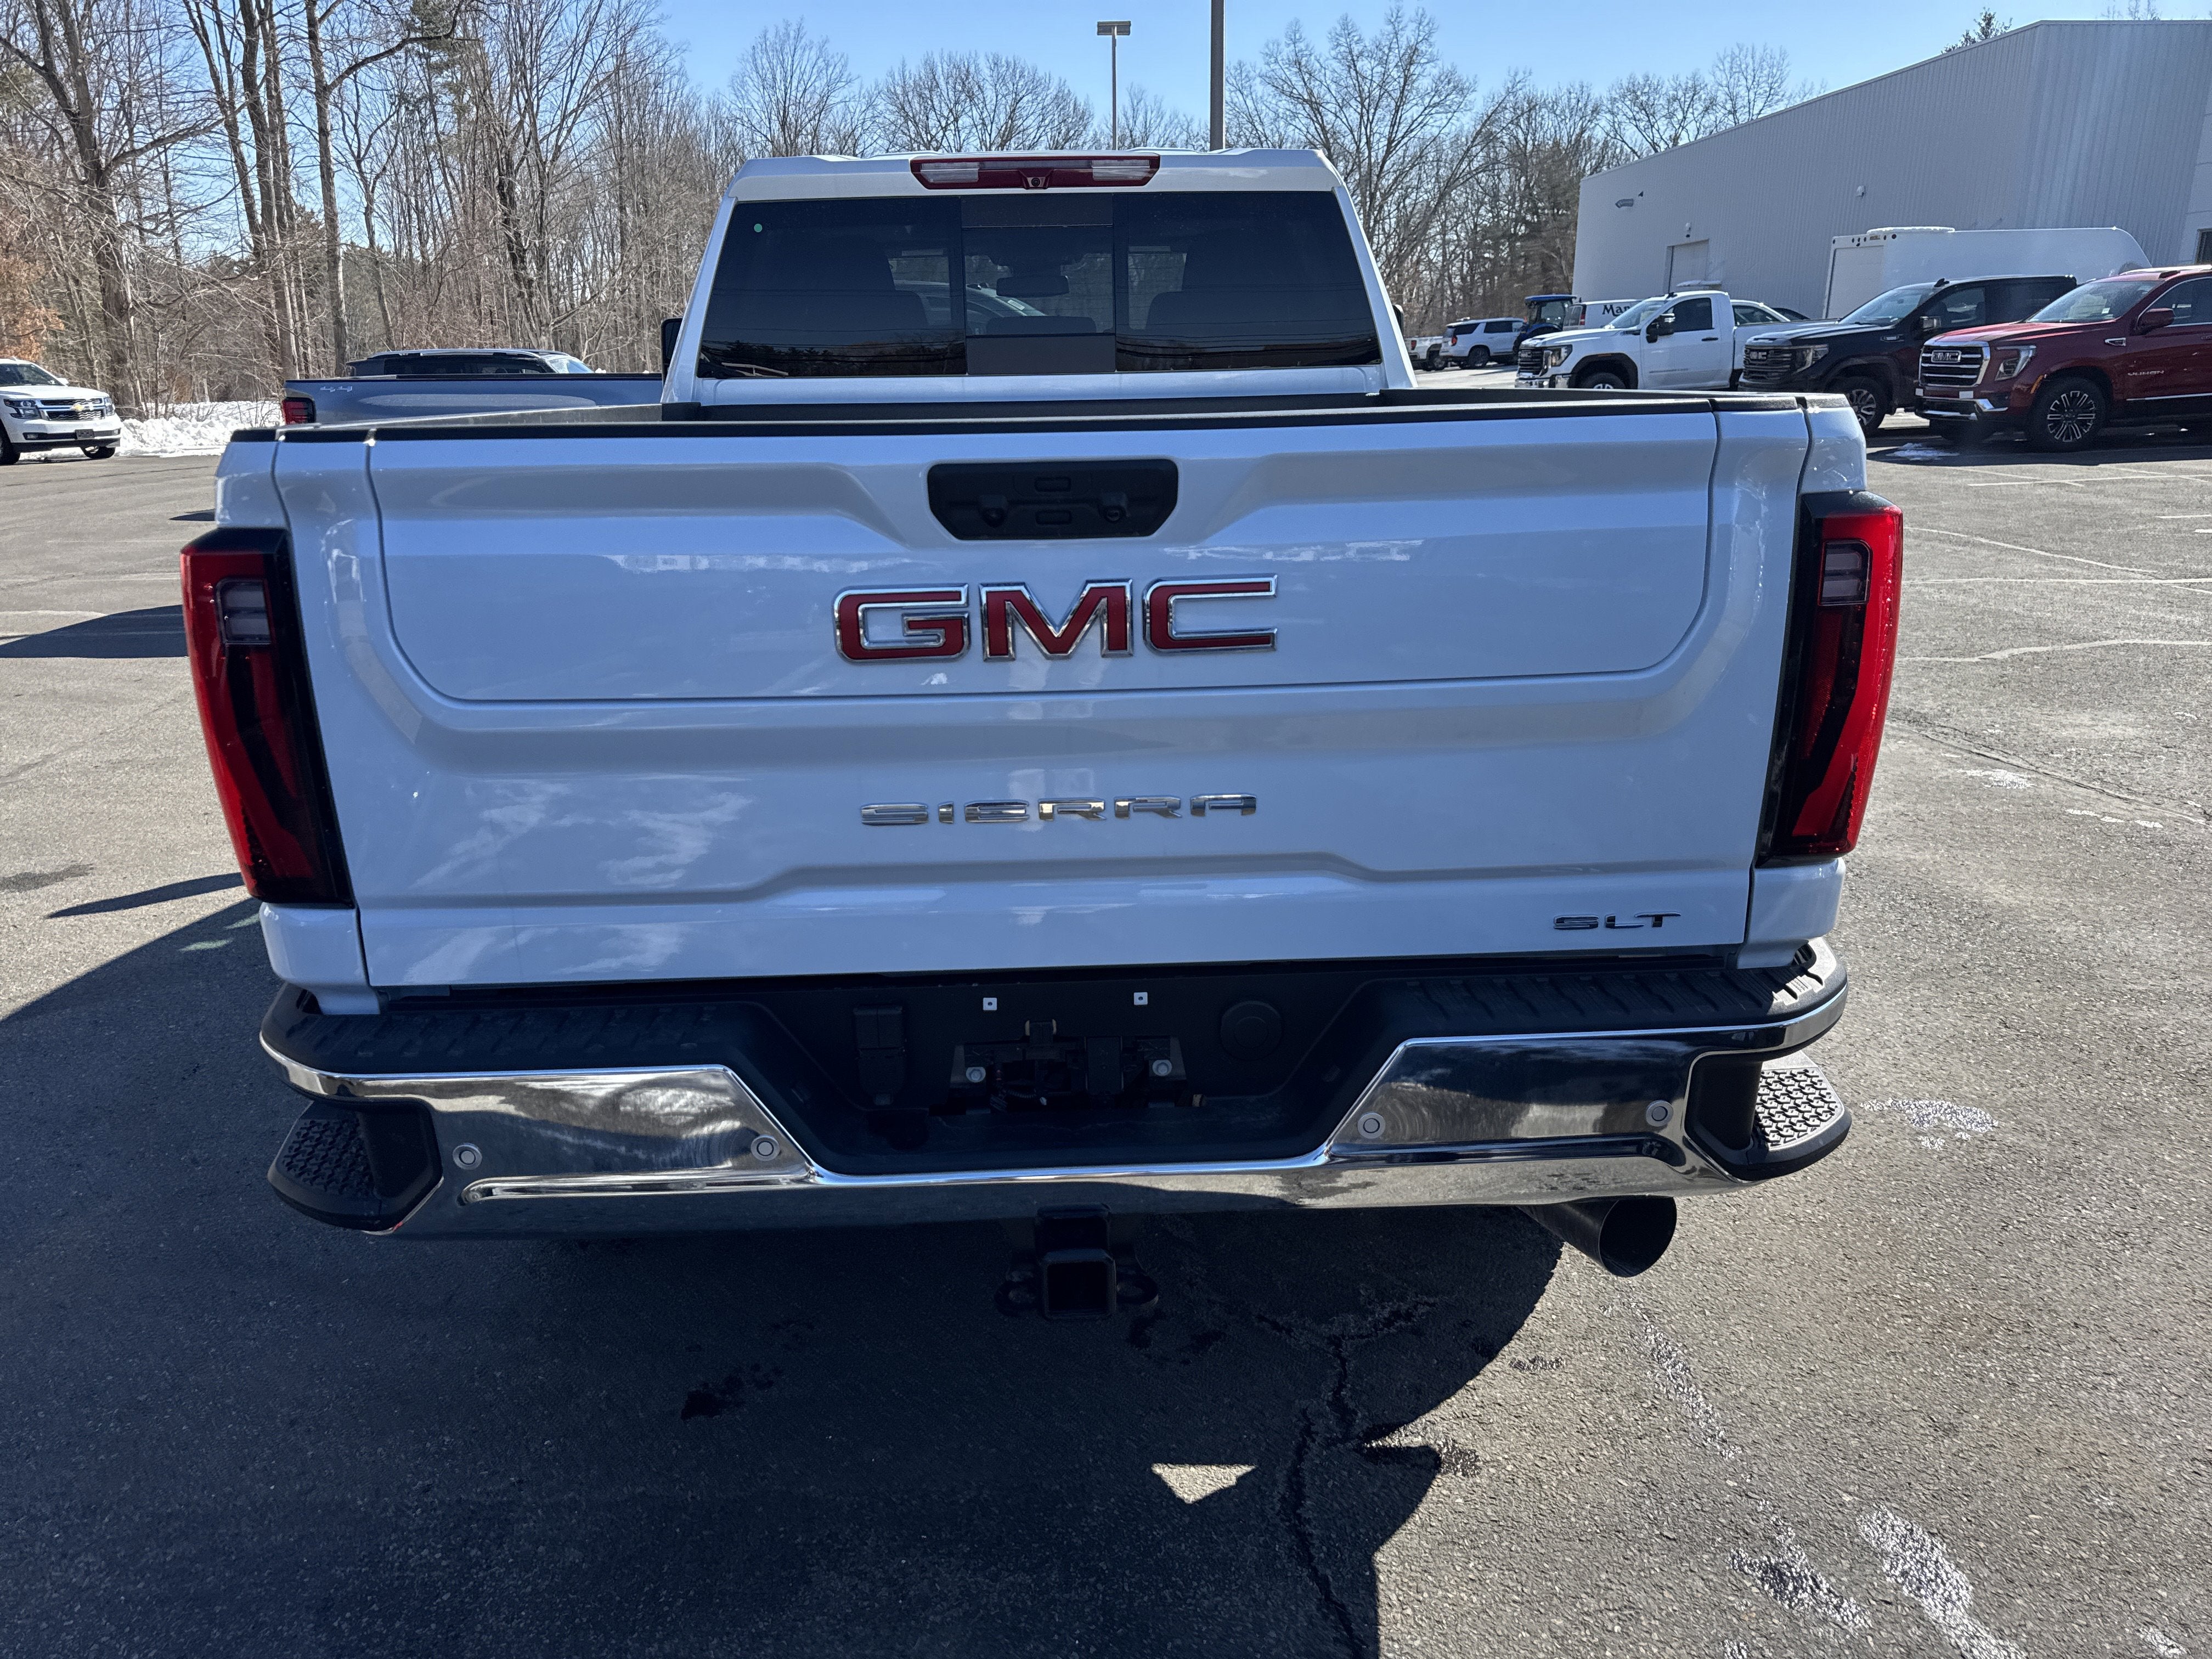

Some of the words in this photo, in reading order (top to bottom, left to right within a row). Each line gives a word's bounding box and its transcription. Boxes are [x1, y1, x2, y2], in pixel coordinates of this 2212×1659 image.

[834, 574, 1279, 663] GMC
[861, 793, 1257, 826] SIERRA
[1553, 911, 1681, 930] SLT
